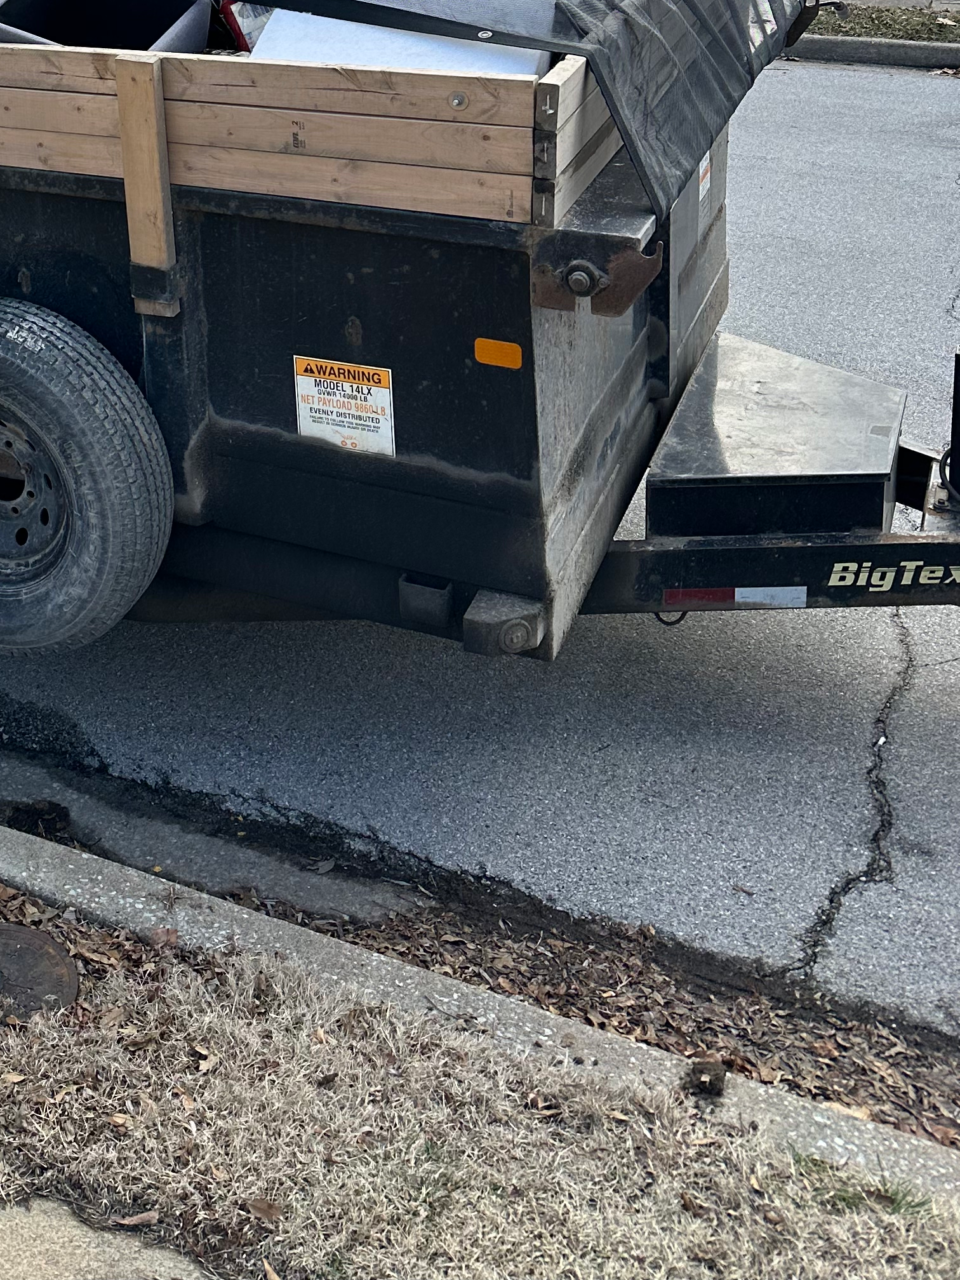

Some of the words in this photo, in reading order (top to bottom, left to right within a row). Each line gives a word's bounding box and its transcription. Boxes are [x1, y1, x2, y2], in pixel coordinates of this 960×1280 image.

[315, 363, 382, 385] WARNING
[314, 379, 347, 393] MODEL
[349, 384, 373, 397] 14LX
[317, 389, 337, 398] GVWR
[339, 392, 358, 400] 14000
[301, 394, 316, 406] NET
[318, 396, 352, 411] PAYLOAD
[354, 403, 374, 415] 9860
[376, 406, 387, 417] LB
[309, 407, 334, 418] EVENLY
[336, 411, 381, 425] DISTRIBUTED
[828, 561, 960, 592] BigTex
